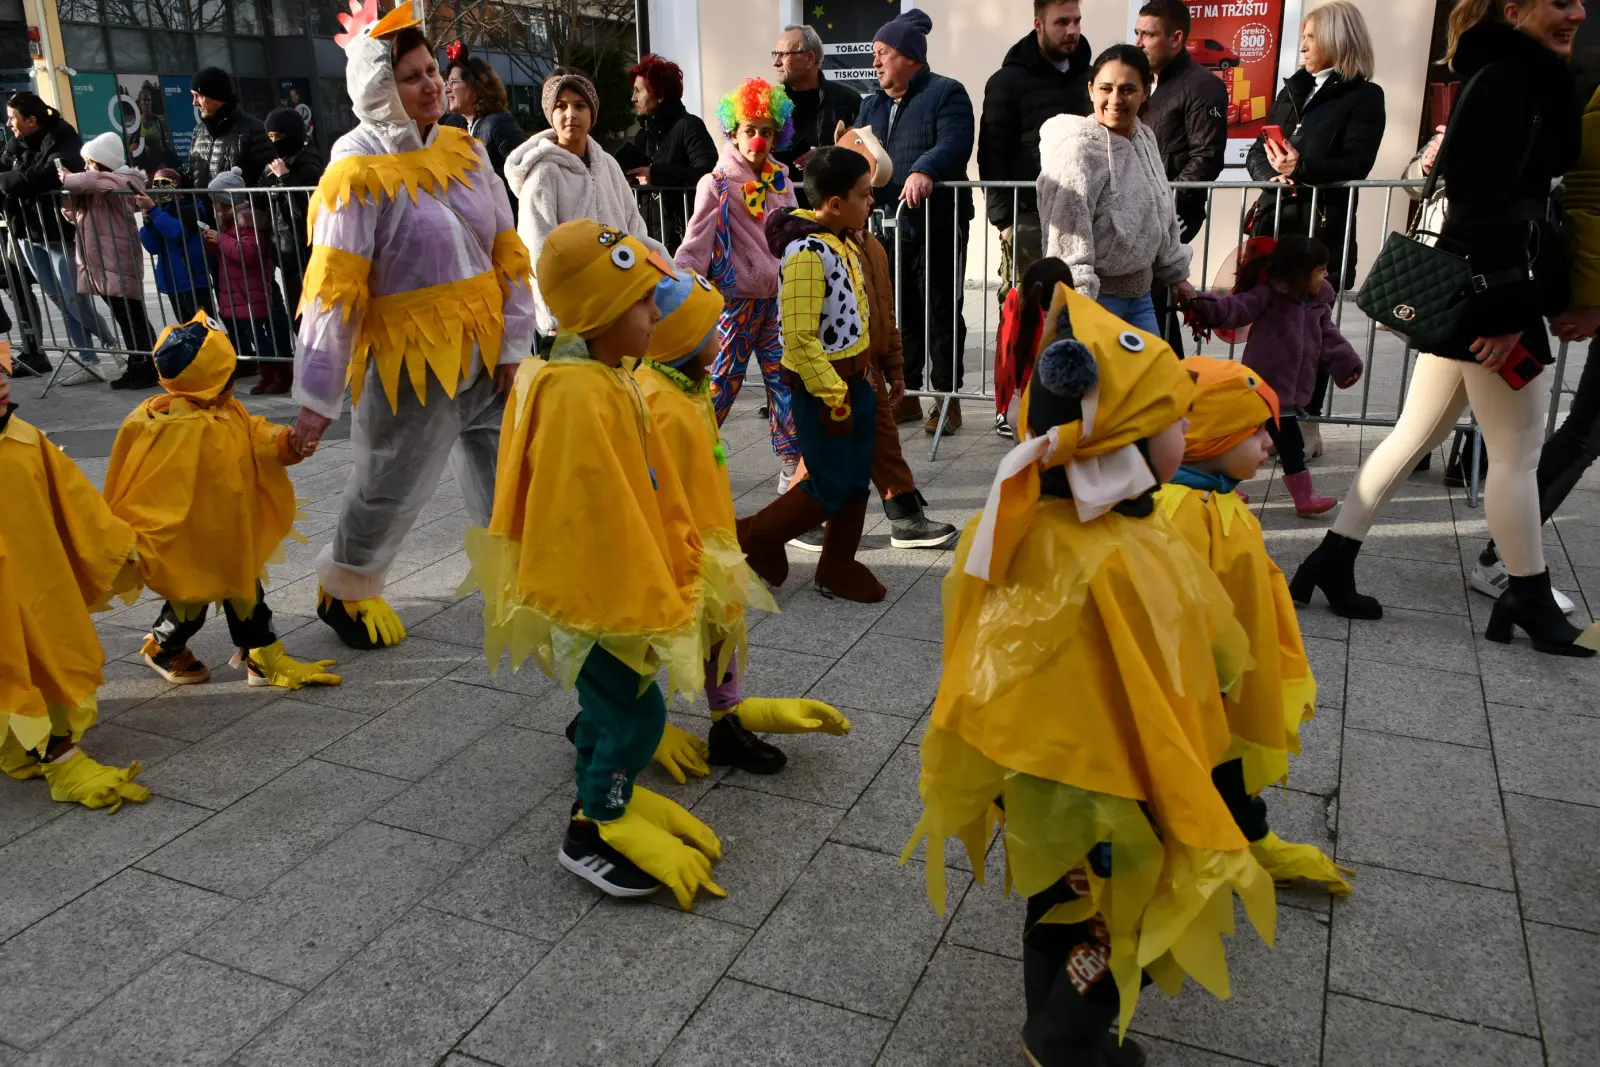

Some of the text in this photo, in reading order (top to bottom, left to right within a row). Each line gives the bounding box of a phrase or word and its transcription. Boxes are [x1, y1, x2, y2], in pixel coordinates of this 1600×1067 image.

[1188, 0, 1268, 18] ET NA TRŽIŠTU
[1241, 27, 1266, 36] preko
[1240, 35, 1265, 48] 800
[834, 70, 878, 79] TISKOVINE
